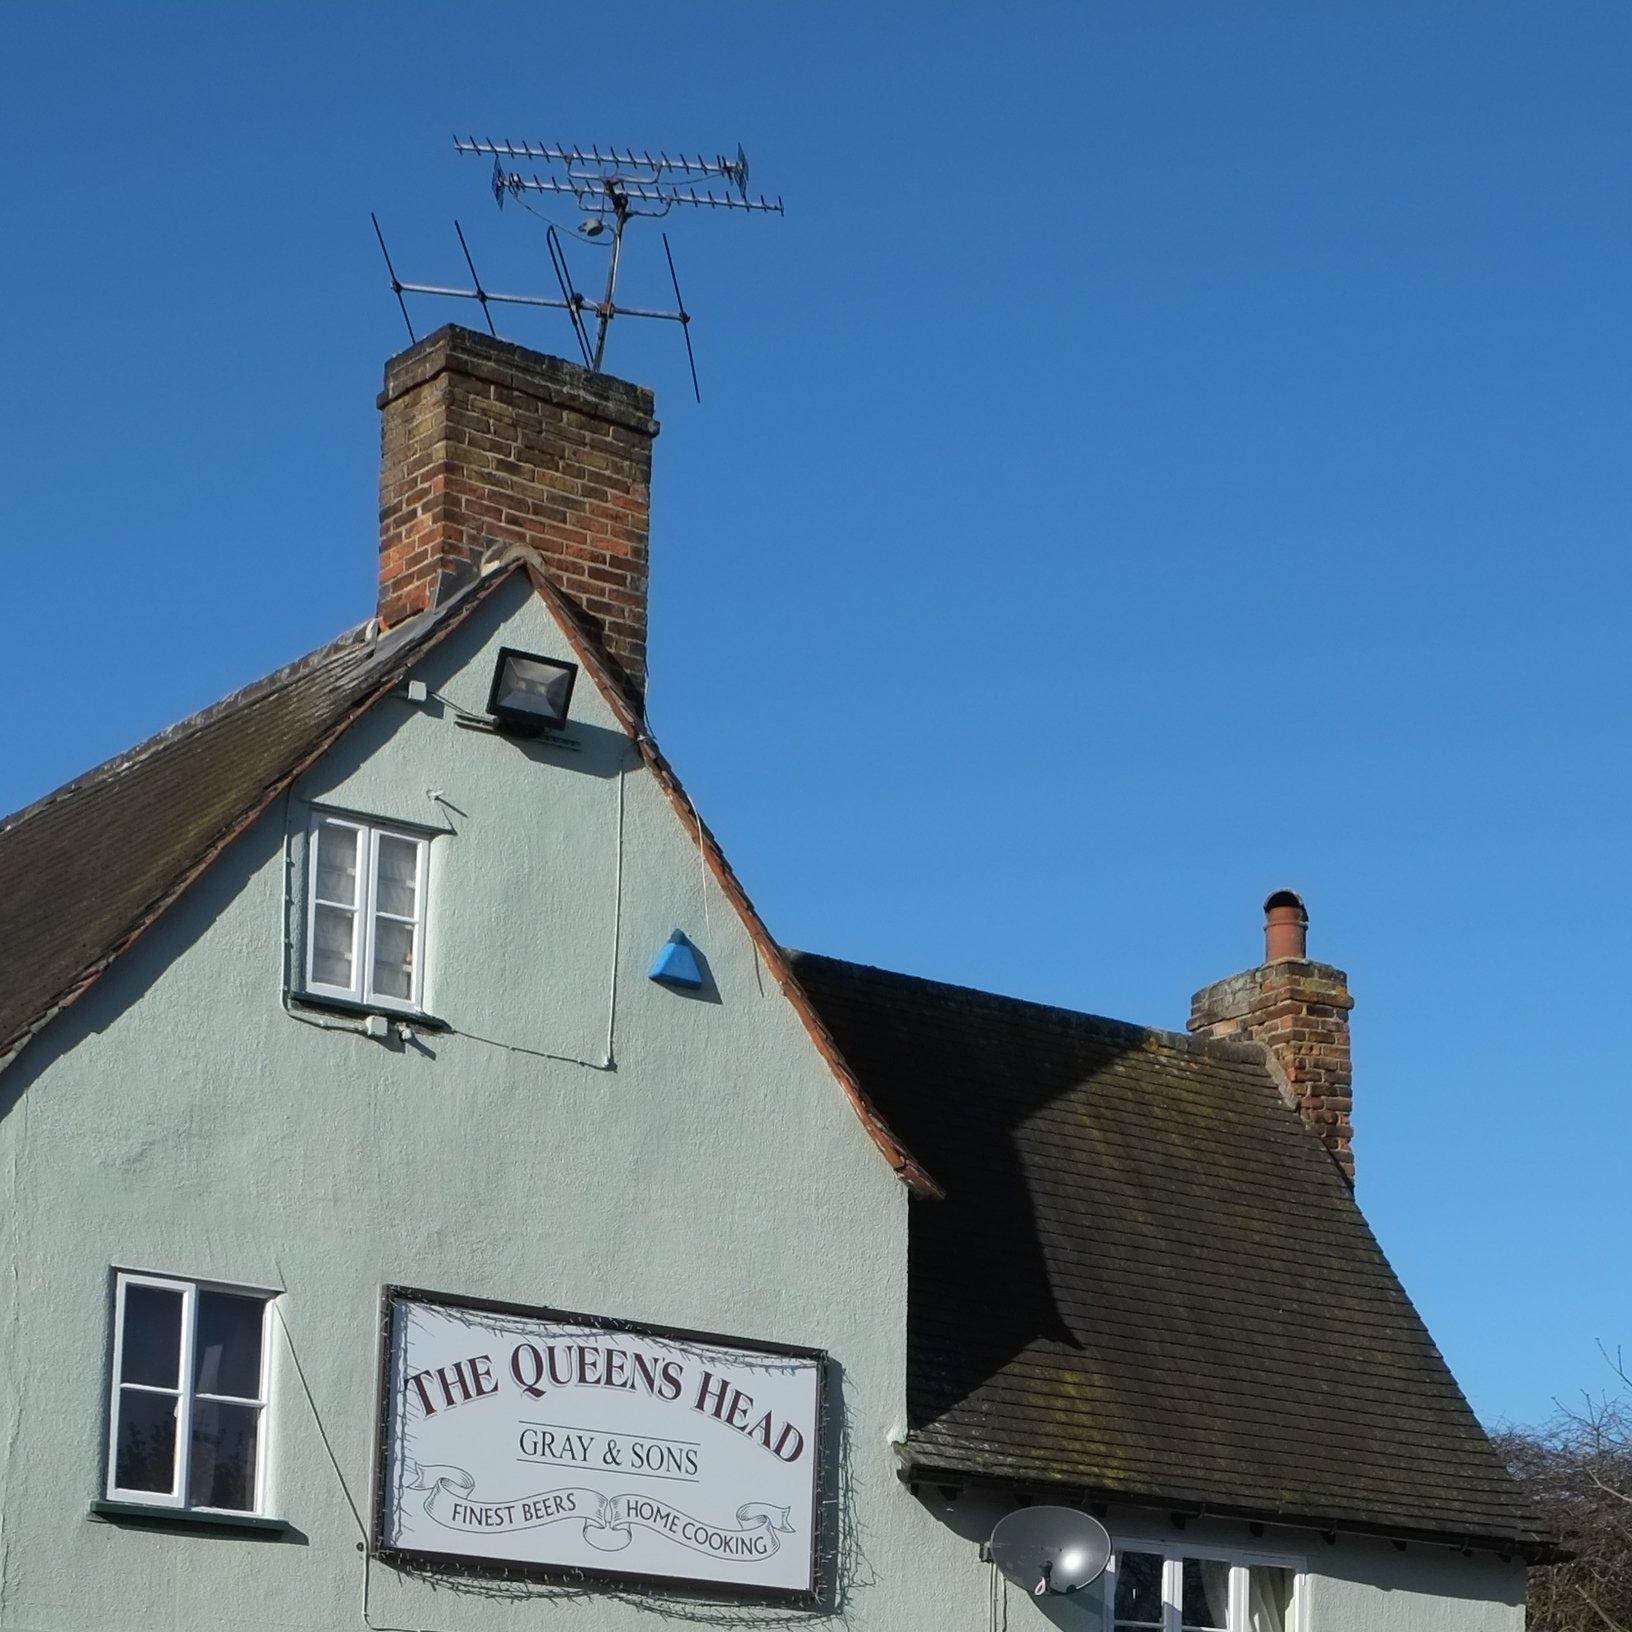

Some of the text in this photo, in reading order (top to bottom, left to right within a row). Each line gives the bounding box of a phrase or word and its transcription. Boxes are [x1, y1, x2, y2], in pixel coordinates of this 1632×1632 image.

[404, 1343, 805, 1463] THE QUEEN'S HEAD
[518, 1427, 699, 1476] GRAY & SONS
[452, 1492, 768, 1557] FINEST BEERS HOME COOKING
